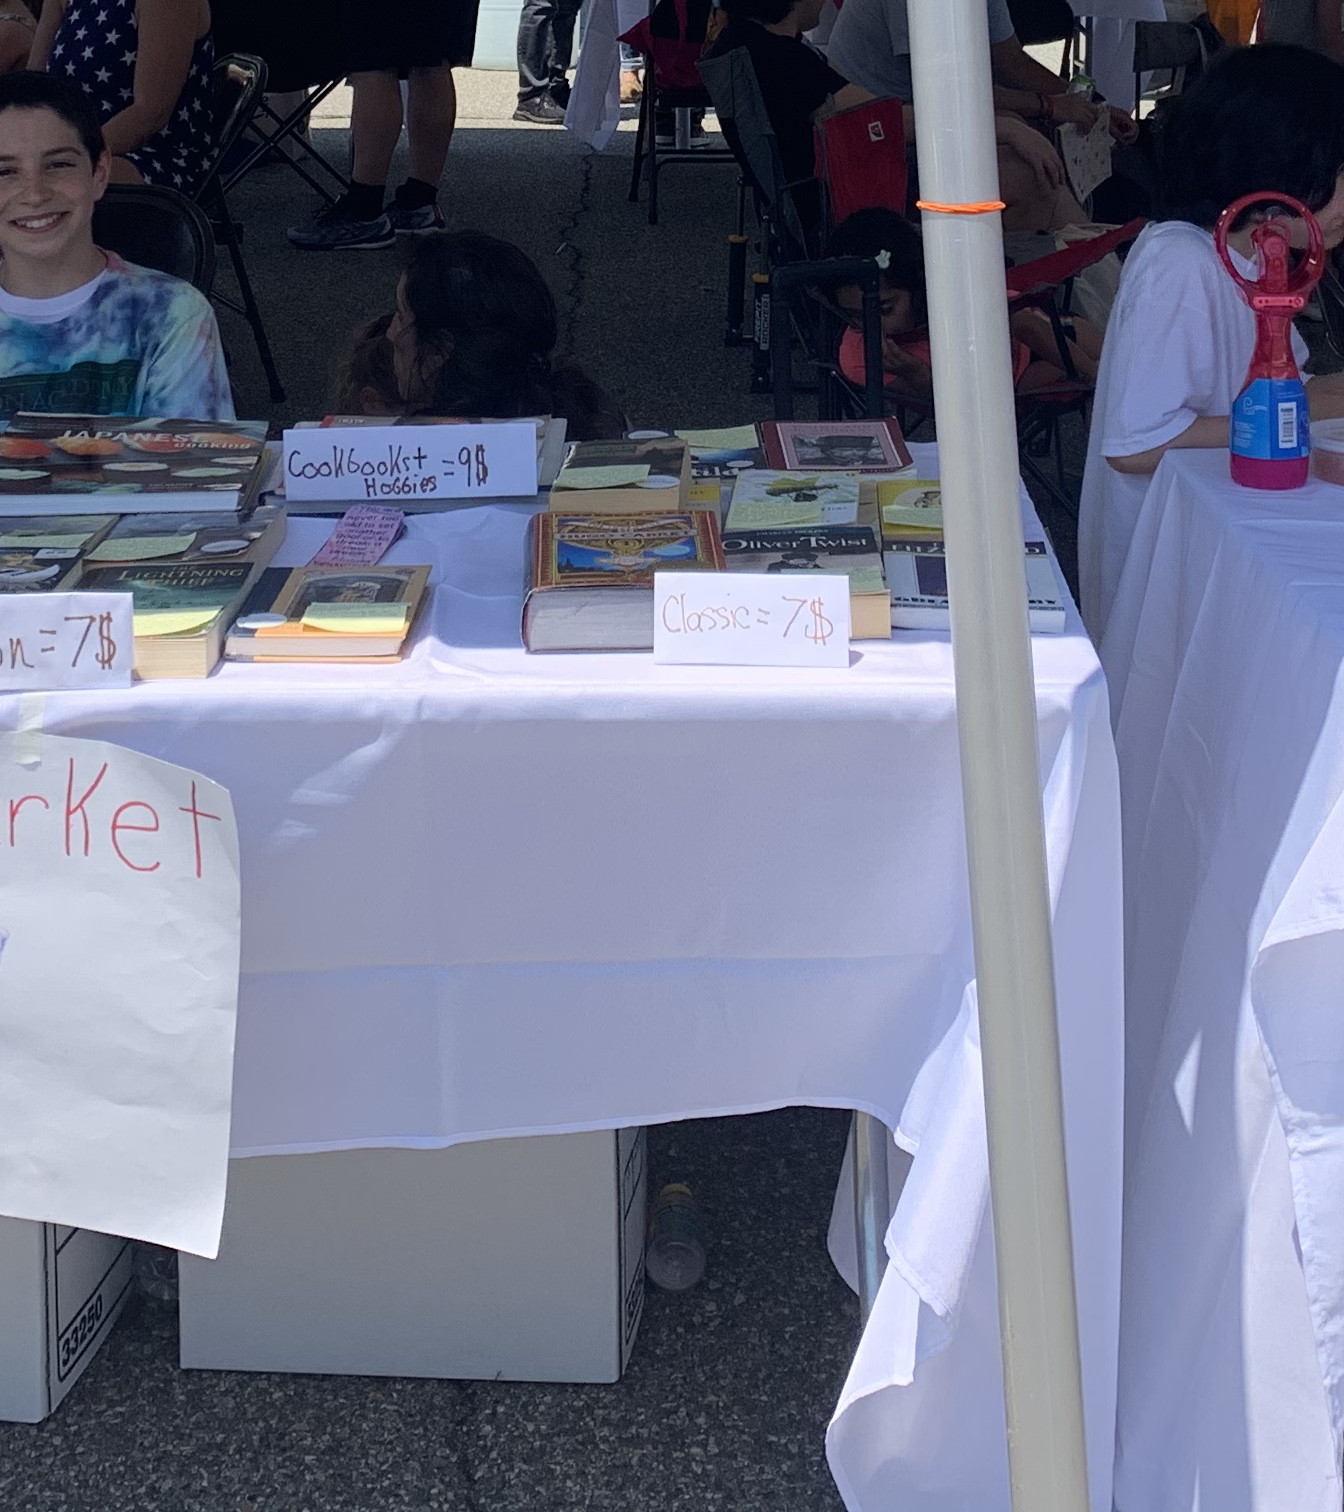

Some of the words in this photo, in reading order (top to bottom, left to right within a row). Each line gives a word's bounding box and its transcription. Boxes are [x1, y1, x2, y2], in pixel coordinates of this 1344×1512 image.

[62, 429, 205, 444] JAPANESE
[722, 538, 800, 551] Oliver
[800, 535, 867, 550] Twist
[116, 568, 244, 581] LIGHTNING
[661, 594, 751, 635] Classic
[779, 597, 834, 647] 7$
[63, 611, 117, 670] 7$
[61, 1292, 103, 1368] 33250
